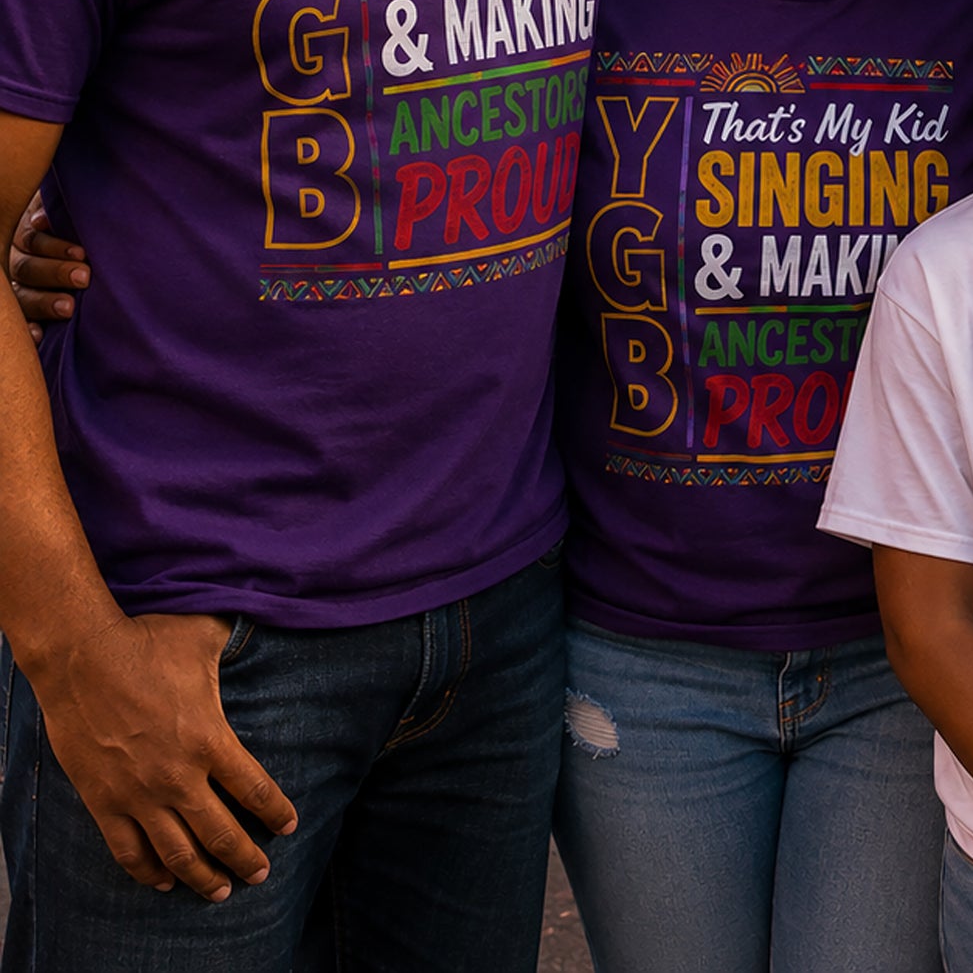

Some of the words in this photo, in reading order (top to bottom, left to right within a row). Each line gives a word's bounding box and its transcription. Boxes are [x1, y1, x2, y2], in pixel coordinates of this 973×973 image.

[389, 66, 589, 156] ANCESTORS
[702, 101, 805, 144] That's
[814, 102, 874, 157] My
[883, 102, 951, 145] Kid
[393, 131, 581, 250] PROUD
[694, 149, 951, 229] SINGING
[694, 233, 744, 301] &
[759, 234, 901, 298] MAKI
[698, 317, 868, 368] ANCEST
[702, 370, 854, 449] PRO
